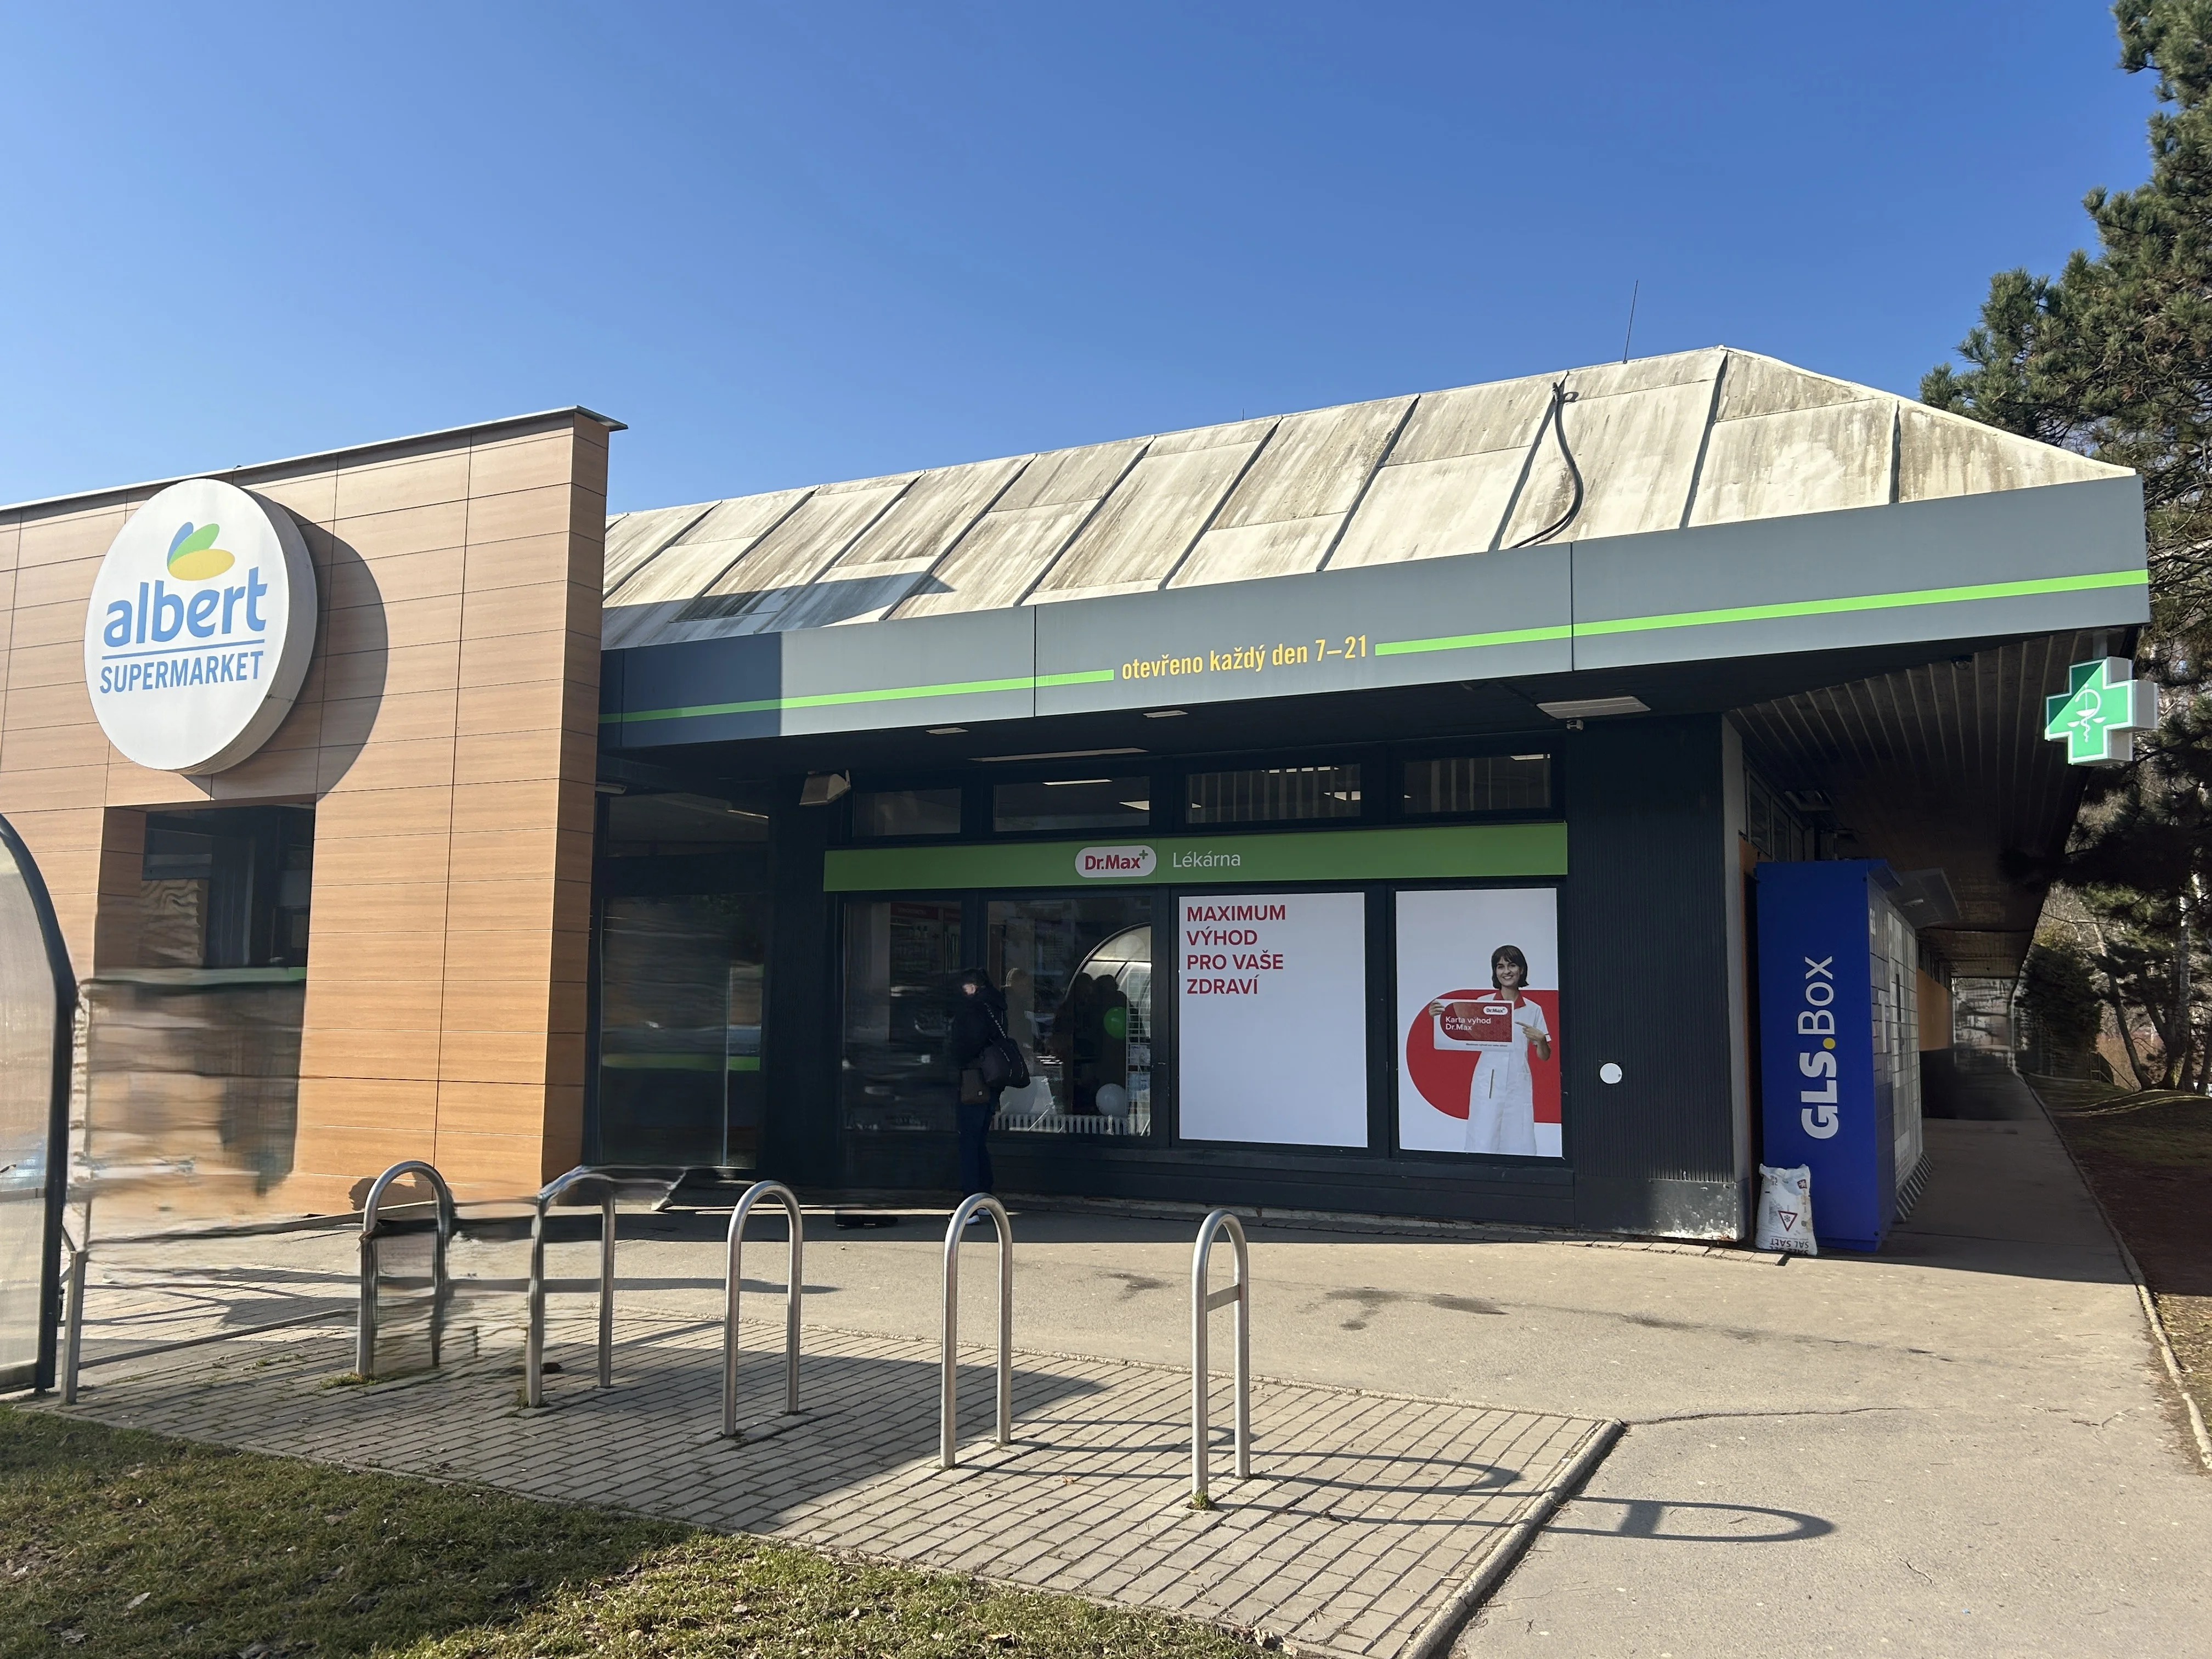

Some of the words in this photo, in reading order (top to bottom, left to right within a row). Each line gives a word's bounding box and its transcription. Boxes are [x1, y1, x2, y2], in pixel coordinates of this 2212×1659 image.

[103, 566, 268, 648] albert
[99, 650, 264, 694] SUPERMARKET
[1121, 653, 1203, 680] otevřeno
[1210, 644, 1266, 672] každý
[1272, 644, 1308, 666] den
[1172, 850, 1241, 868] Lékárna
[1187, 904, 1286, 922] MAXIMUM
[1186, 926, 1258, 946] VÝHOD
[1187, 953, 1227, 970] PRO
[1232, 949, 1284, 970] VAŠE
[1187, 974, 1260, 995] ZDRAVÍ
[1769, 1238, 1792, 1248] SALT
